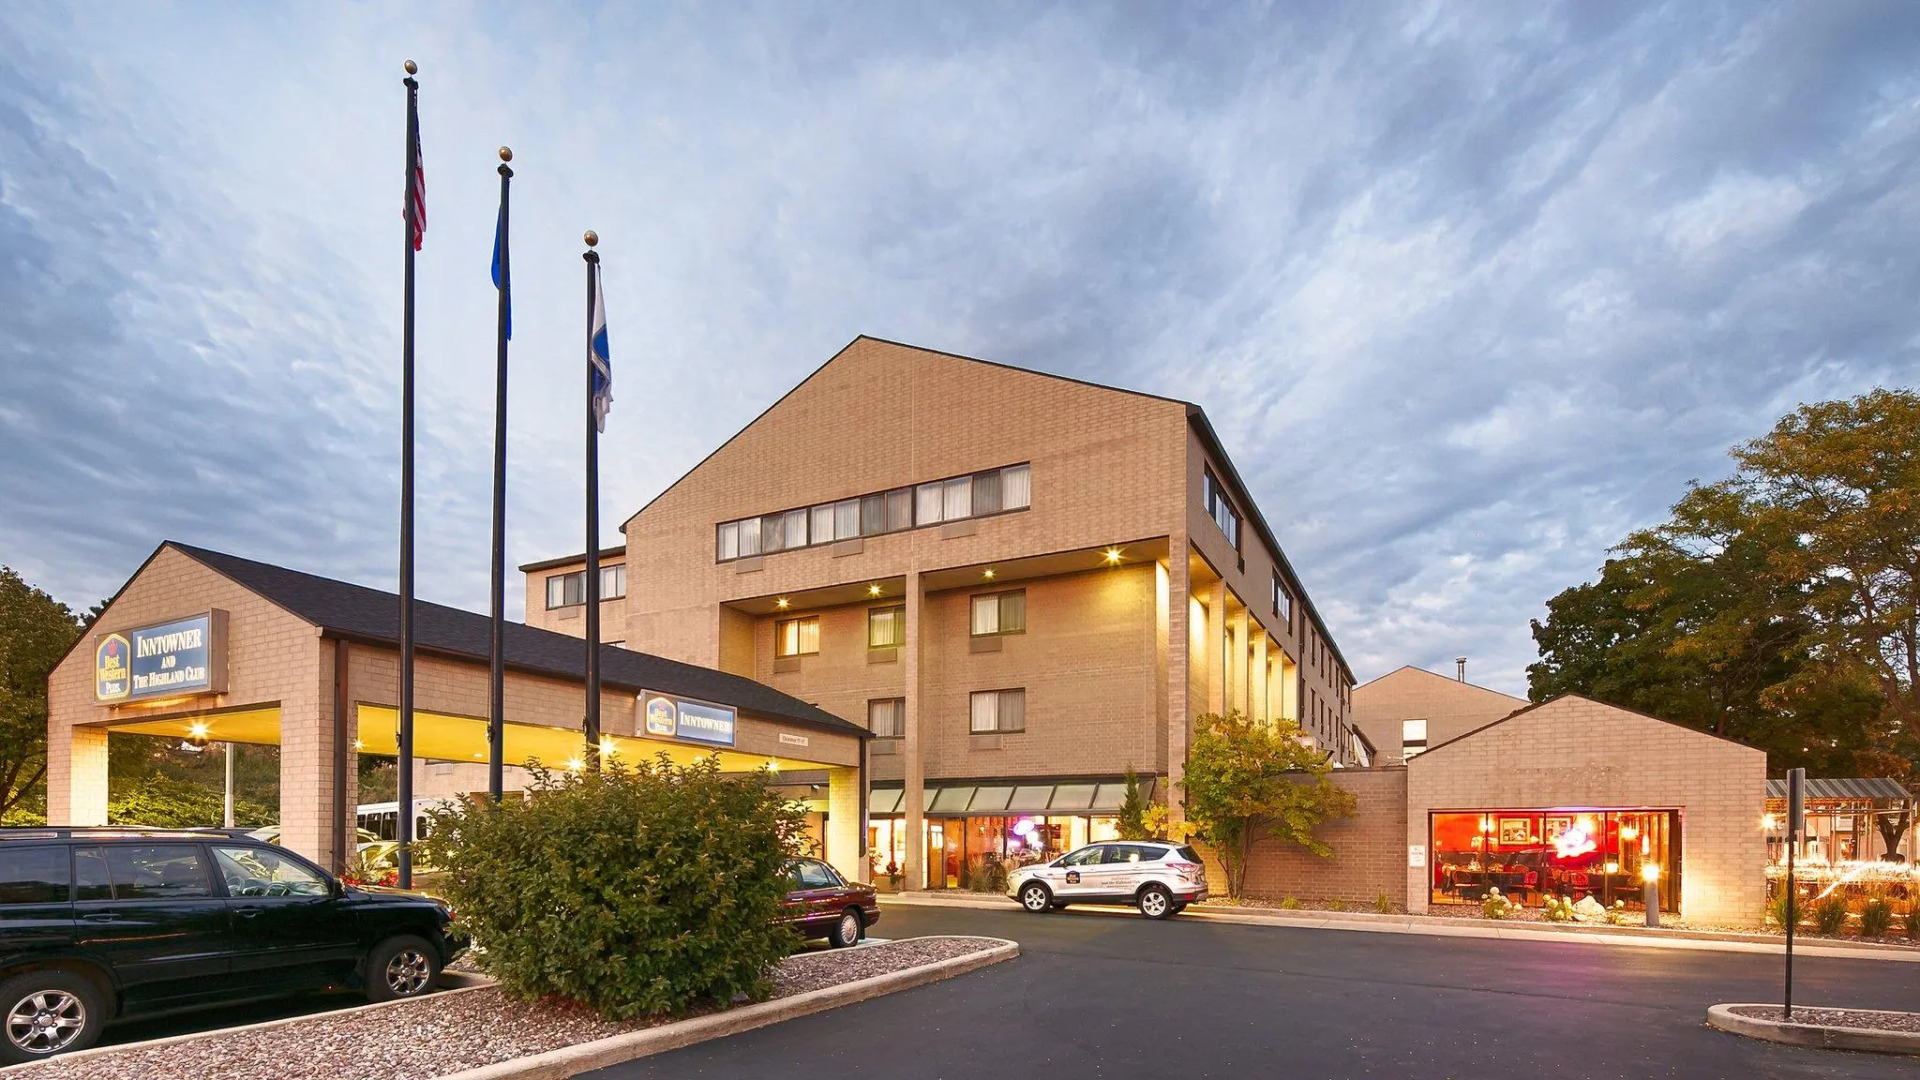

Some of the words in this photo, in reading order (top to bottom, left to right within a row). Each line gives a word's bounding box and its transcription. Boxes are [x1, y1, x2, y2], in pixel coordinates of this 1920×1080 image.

[137, 629, 202, 658] INNTOWNER
[161, 655, 176, 669] AND
[133, 674, 148, 689] THE
[148, 670, 185, 687] HIGHLAND
[185, 666, 205, 681] CLUB
